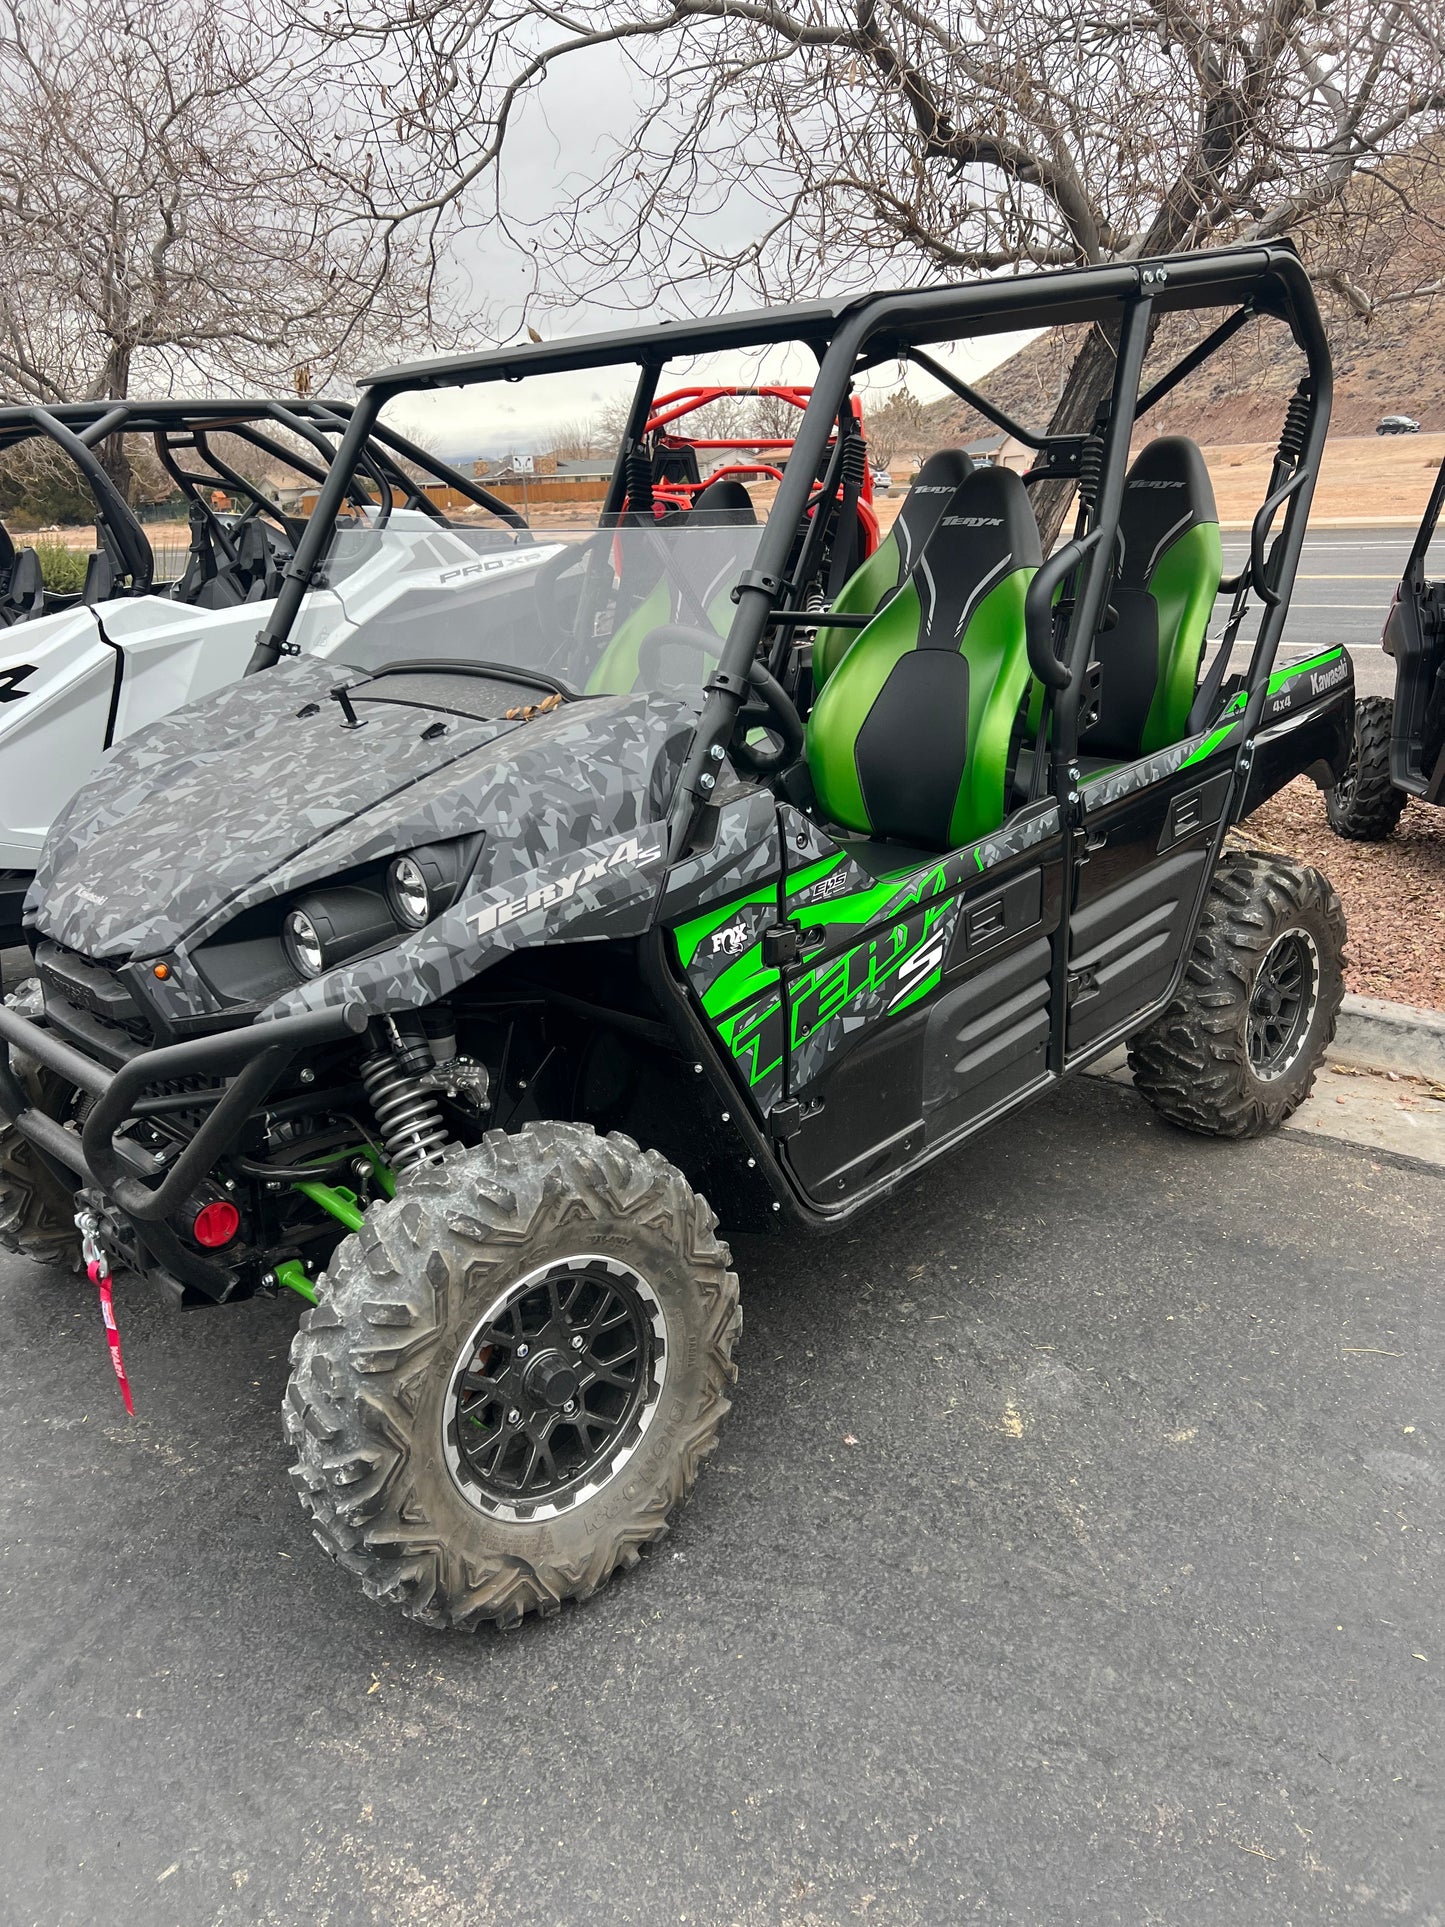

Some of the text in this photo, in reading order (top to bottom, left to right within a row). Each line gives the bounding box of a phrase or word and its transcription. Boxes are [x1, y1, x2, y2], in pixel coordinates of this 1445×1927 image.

[941, 515, 1005, 527] TERYX
[1310, 657, 1348, 696] Kawasaki
[1272, 695, 1292, 712] 4x4
[813, 871, 848, 897] EPS
[711, 922, 748, 955] FOX
[109, 1345, 126, 1380] WARN
